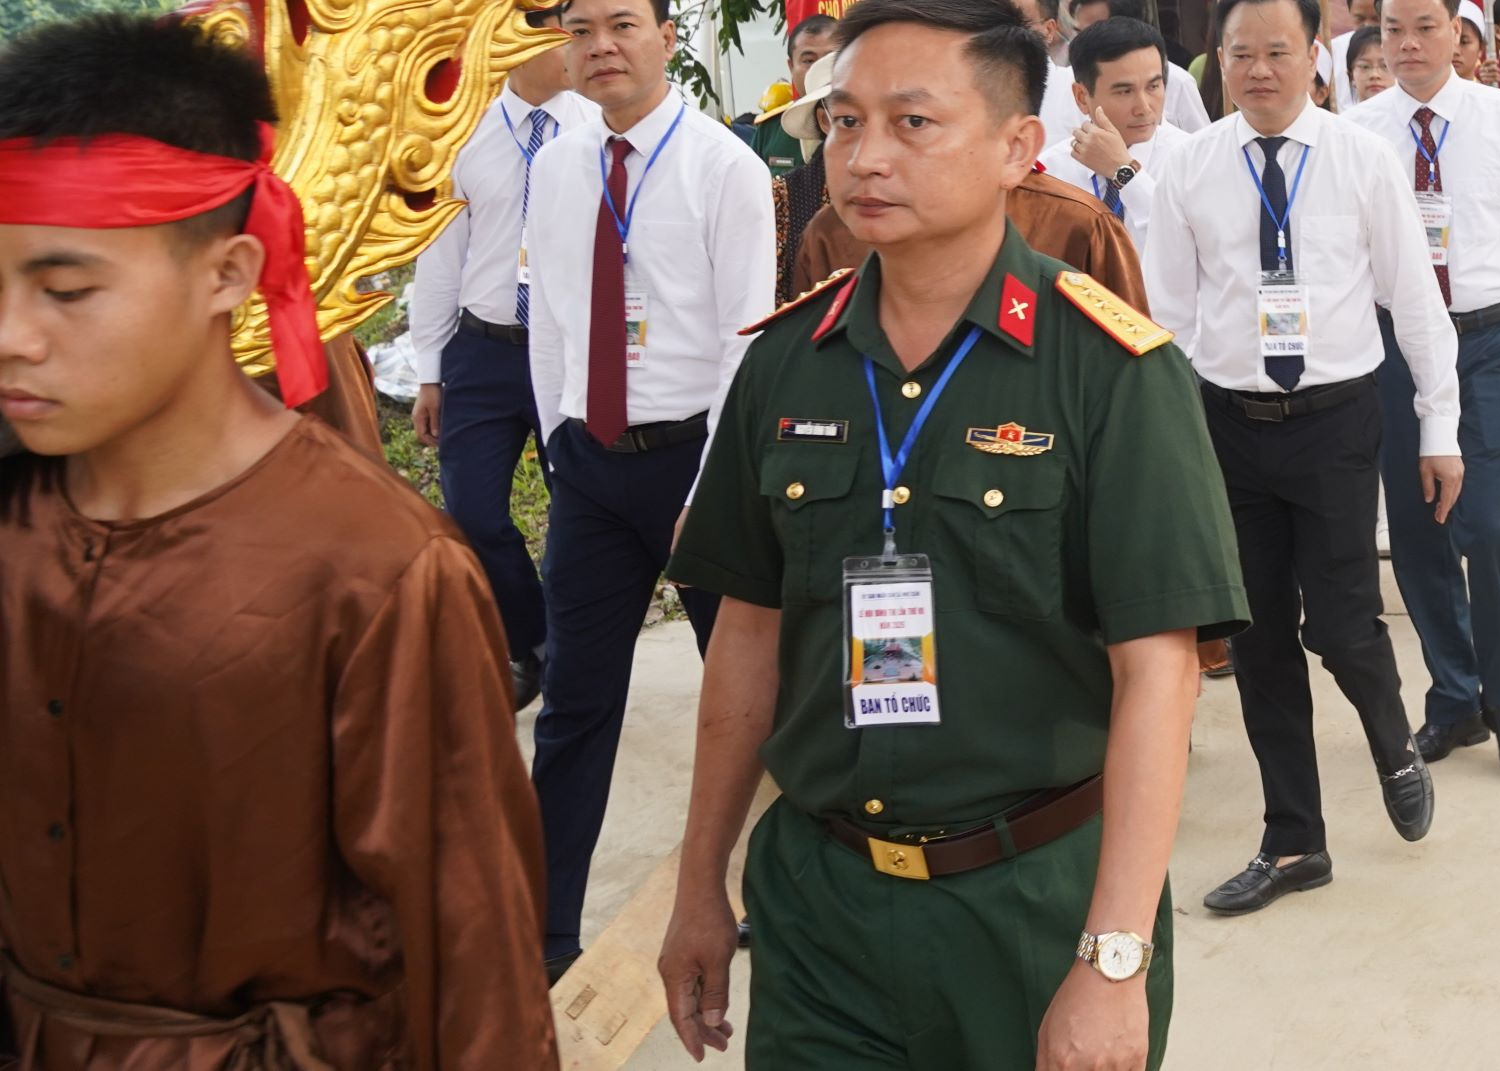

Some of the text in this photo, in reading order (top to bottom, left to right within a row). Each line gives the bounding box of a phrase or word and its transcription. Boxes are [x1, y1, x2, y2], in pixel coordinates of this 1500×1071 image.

[860, 691, 931, 714] BAN TỔ CHỨC
